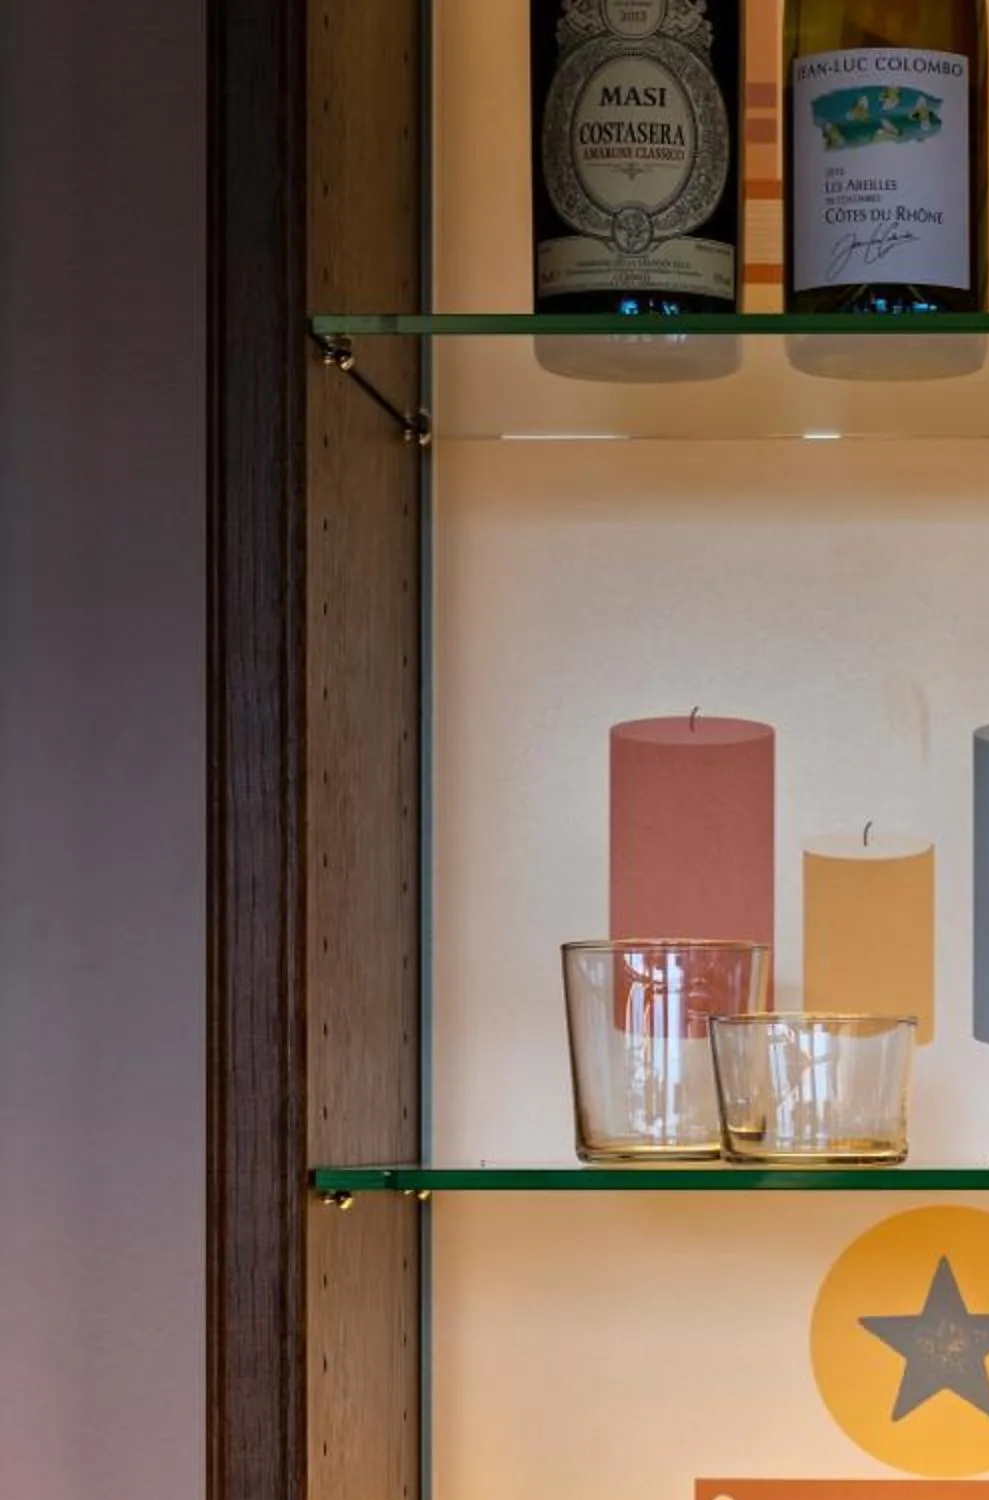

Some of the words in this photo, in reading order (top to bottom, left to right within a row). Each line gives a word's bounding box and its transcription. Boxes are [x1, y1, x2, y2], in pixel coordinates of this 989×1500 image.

[796, 57, 868, 81] JEAN-LUC
[875, 57, 964, 77] COLOMBO
[600, 86, 667, 107] MASI
[579, 121, 685, 146] COSTASERA
[825, 206, 867, 224] CÔTES
[870, 208, 892, 222] DU
[896, 205, 944, 225] RHÔNE
